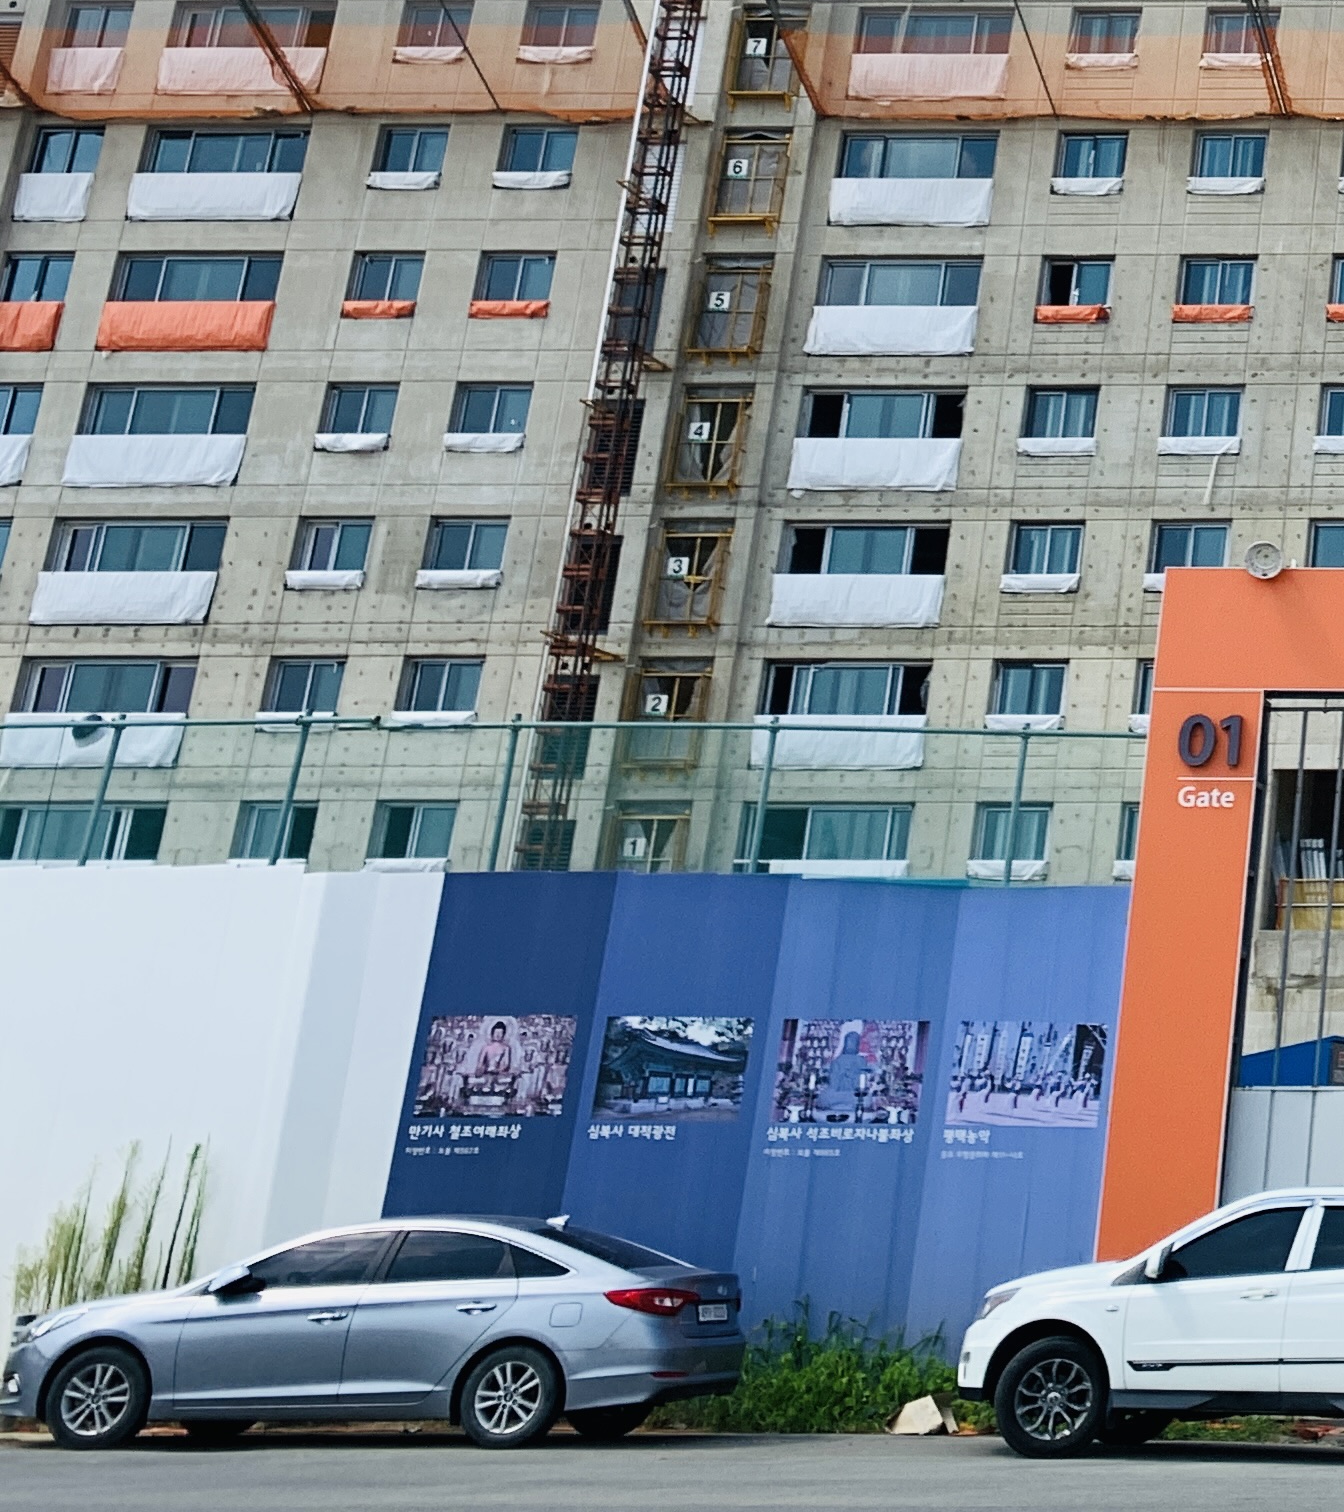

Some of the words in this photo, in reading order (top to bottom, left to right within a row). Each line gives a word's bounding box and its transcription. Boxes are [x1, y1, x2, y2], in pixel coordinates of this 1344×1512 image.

[1178, 714, 1243, 768] 01
[1177, 785, 1235, 808] Gate
[587, 1124, 624, 1140] 심복사
[767, 1126, 802, 1141] 심복사
